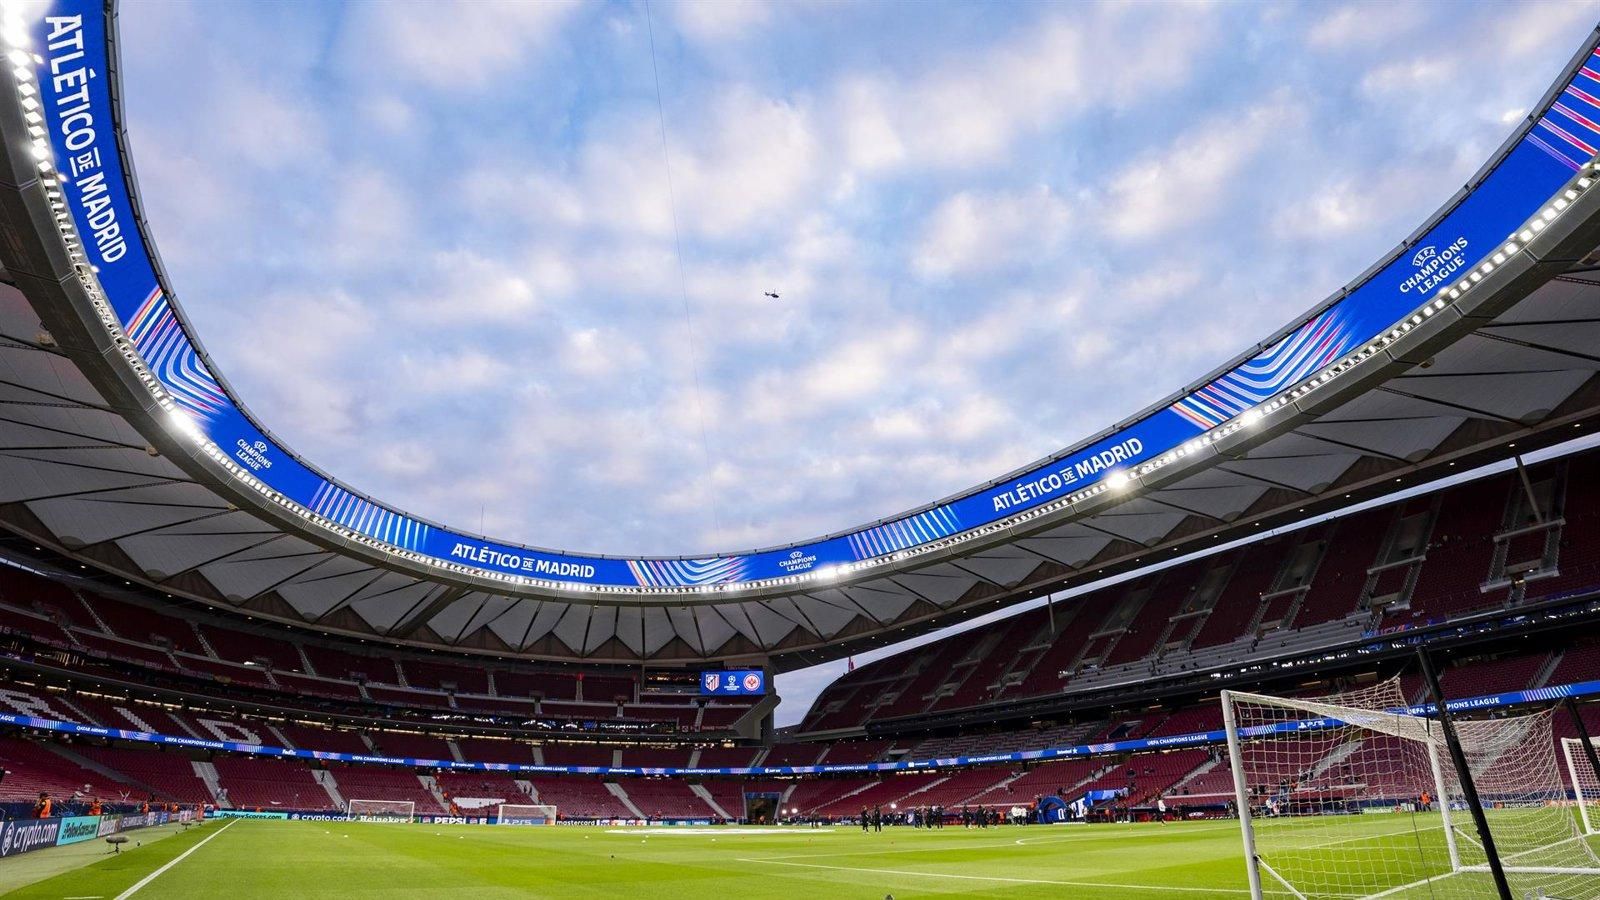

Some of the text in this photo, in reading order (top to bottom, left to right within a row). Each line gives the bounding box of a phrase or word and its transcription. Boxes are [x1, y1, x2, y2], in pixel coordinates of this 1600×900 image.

[45, 14, 128, 264] ATLÉTICO DE MADRID
[1400, 237, 1468, 293] CHAMPIONS
[1414, 248, 1436, 267] UEFA
[1418, 255, 1466, 295] LEAGUE
[236, 438, 272, 469] CHAMPIONS
[236, 449, 261, 471] LEAGUE
[992, 437, 1143, 512] ATLÉTICO DE MADRID
[451, 543, 595, 578] ATLÉTICO DE MADRID
[779, 555, 817, 567] CHAMPIONS
[787, 563, 811, 572] LEAGUE
[1470, 697, 1500, 707] LEAGUE
[177, 738, 205, 746] CHAMPIONS
[1159, 737, 1188, 745] CHAMPIONS
[434, 817, 467, 825] PEPSI
[13, 820, 58, 852] crypto.com
